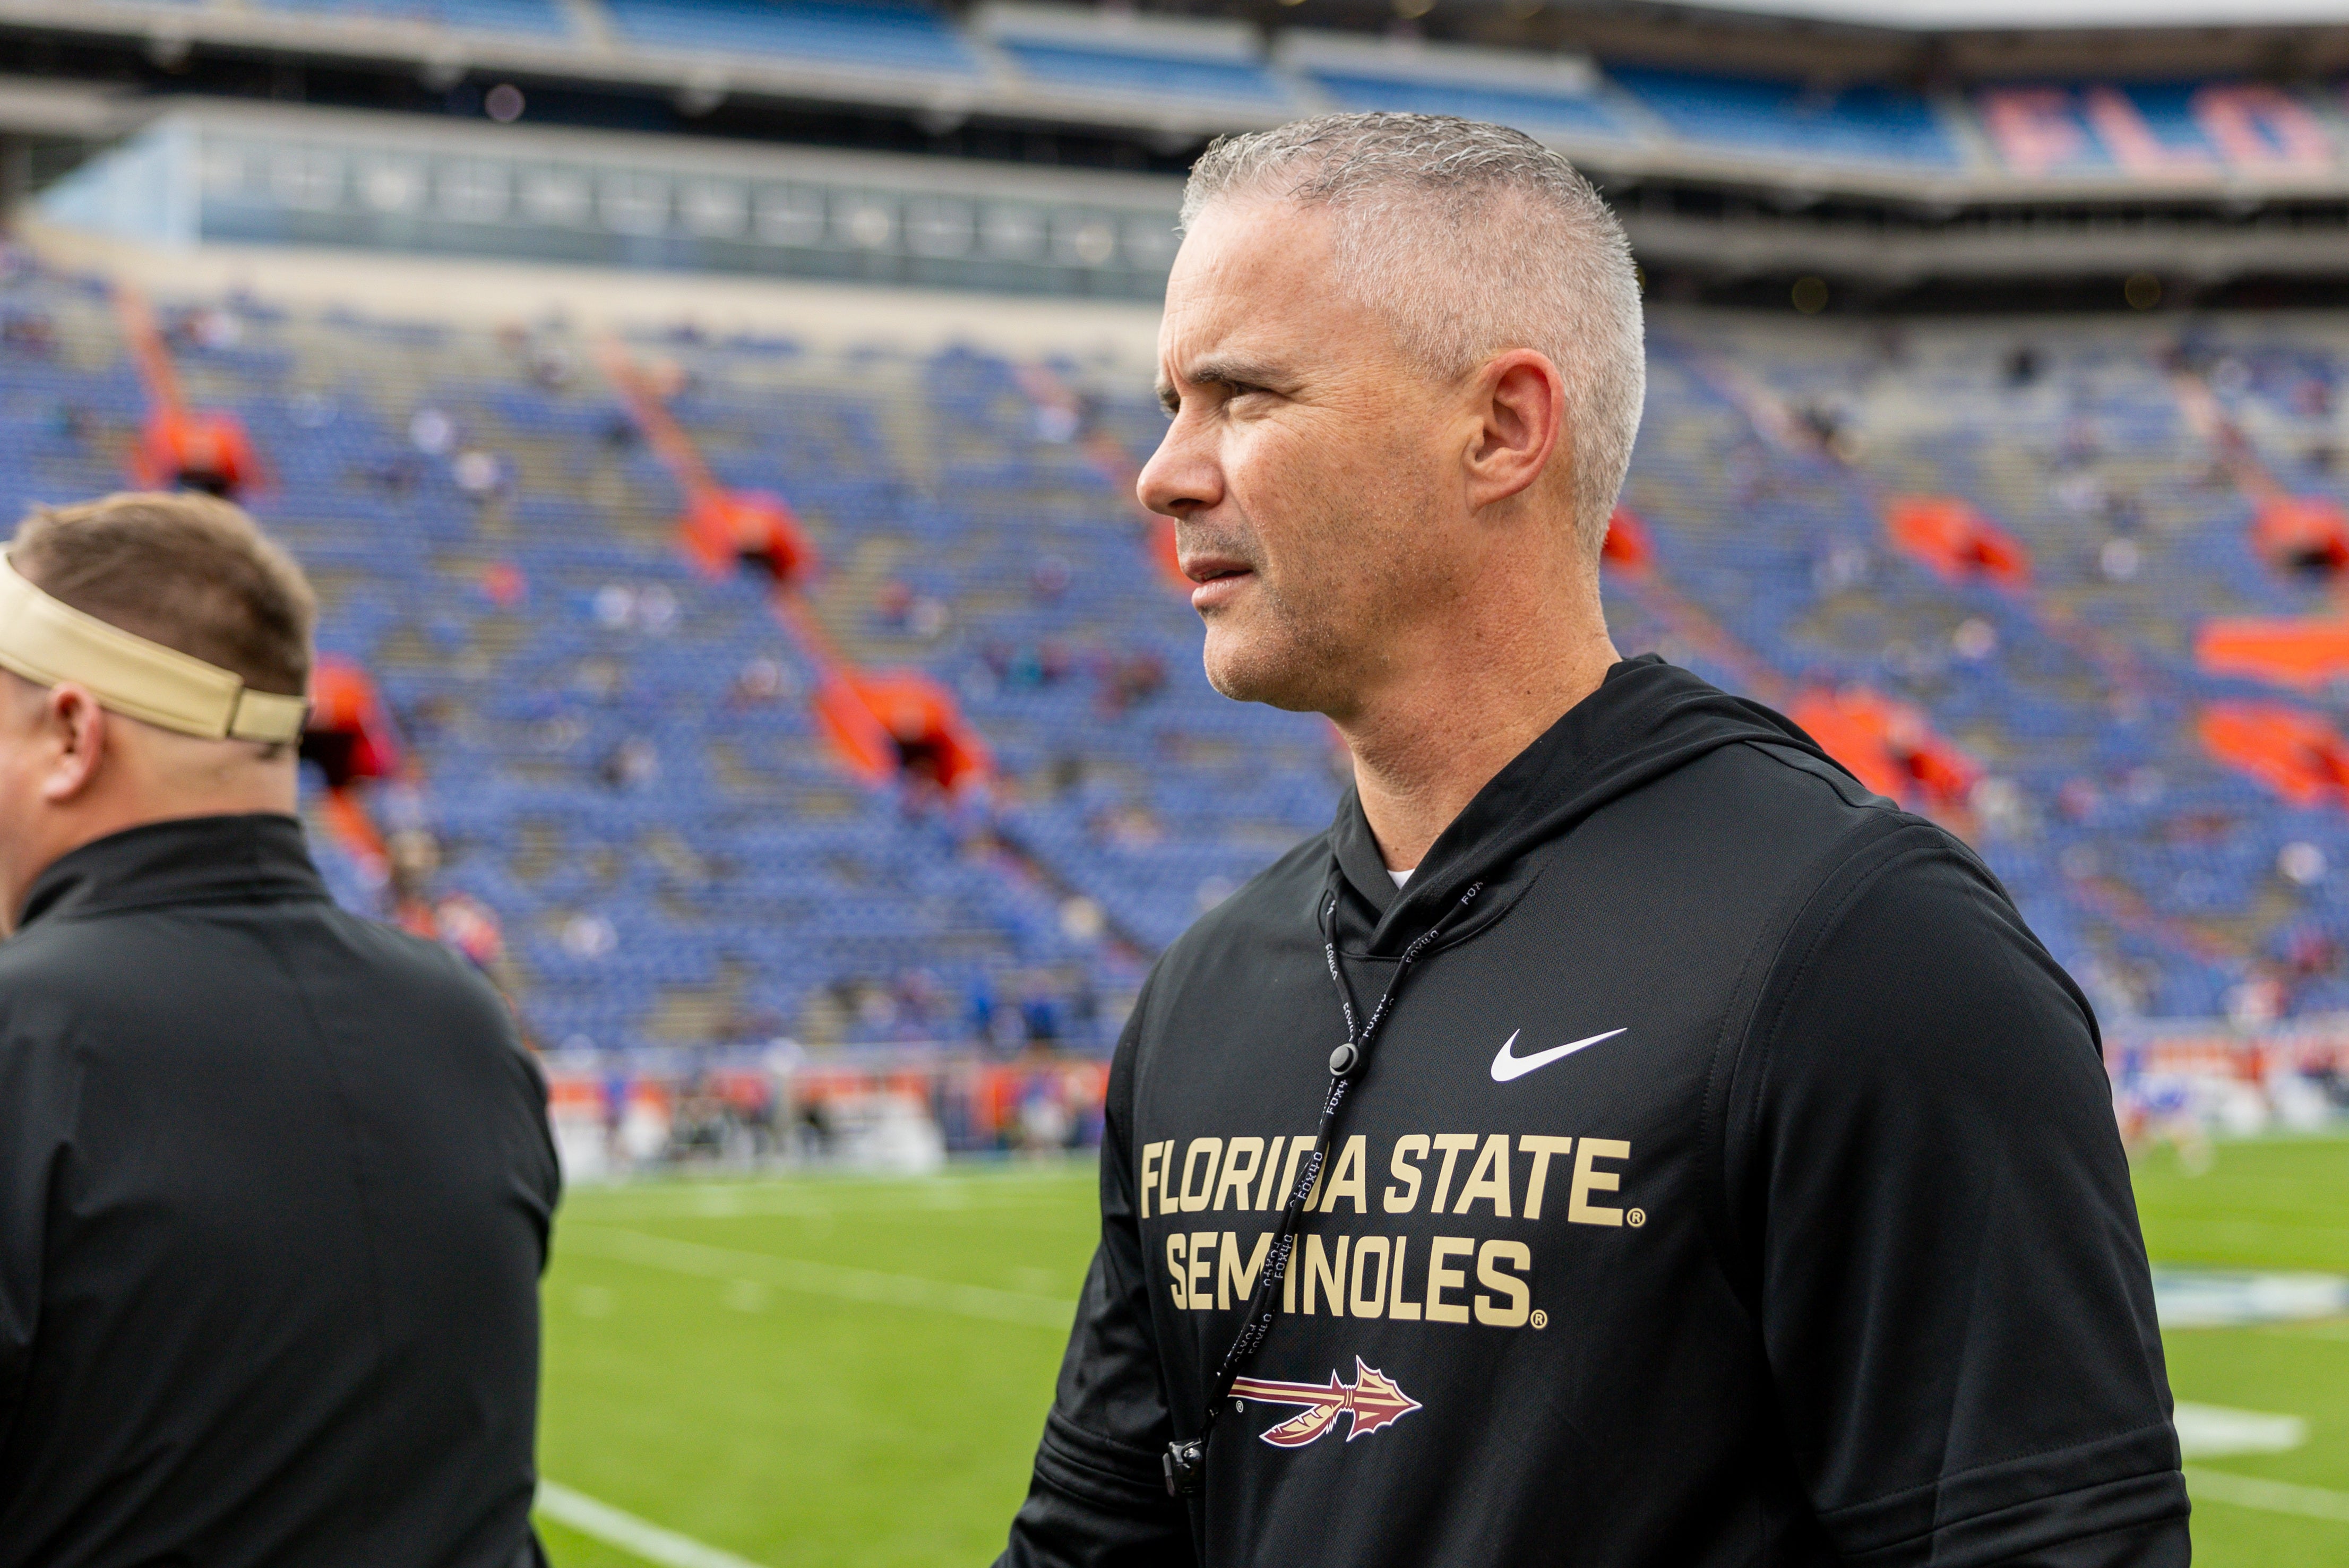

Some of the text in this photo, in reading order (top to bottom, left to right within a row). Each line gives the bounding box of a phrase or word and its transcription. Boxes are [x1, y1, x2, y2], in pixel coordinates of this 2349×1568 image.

[1297, 1151, 1323, 1200] FOX40
[1166, 1230, 1531, 1329] SEMINOLES
[1274, 1234, 1293, 1279] FOX40
